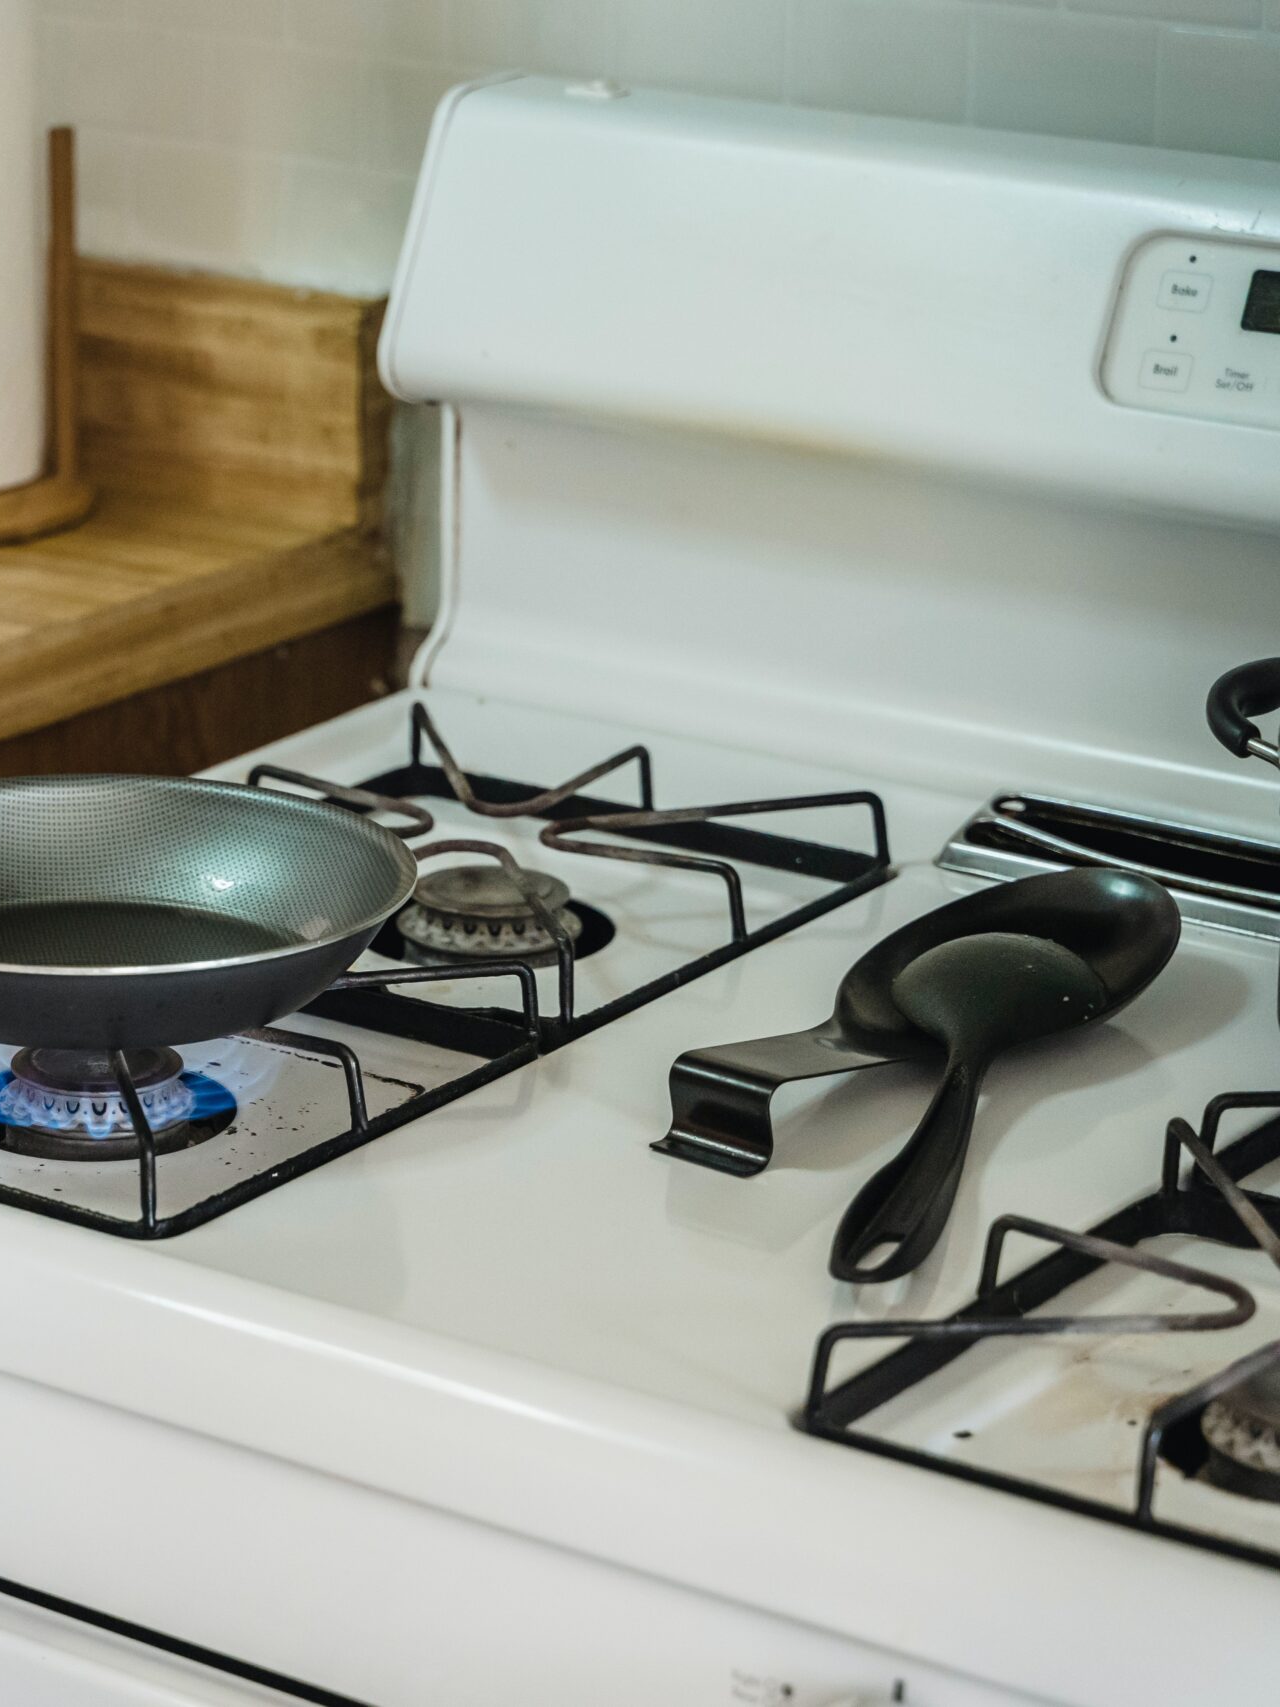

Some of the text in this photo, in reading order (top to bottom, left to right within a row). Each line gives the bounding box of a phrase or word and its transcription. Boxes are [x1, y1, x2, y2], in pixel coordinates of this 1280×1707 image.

[1171, 283, 1198, 297] Bake
[1153, 363, 1178, 376] Broil
[1225, 367, 1250, 379] Timer
